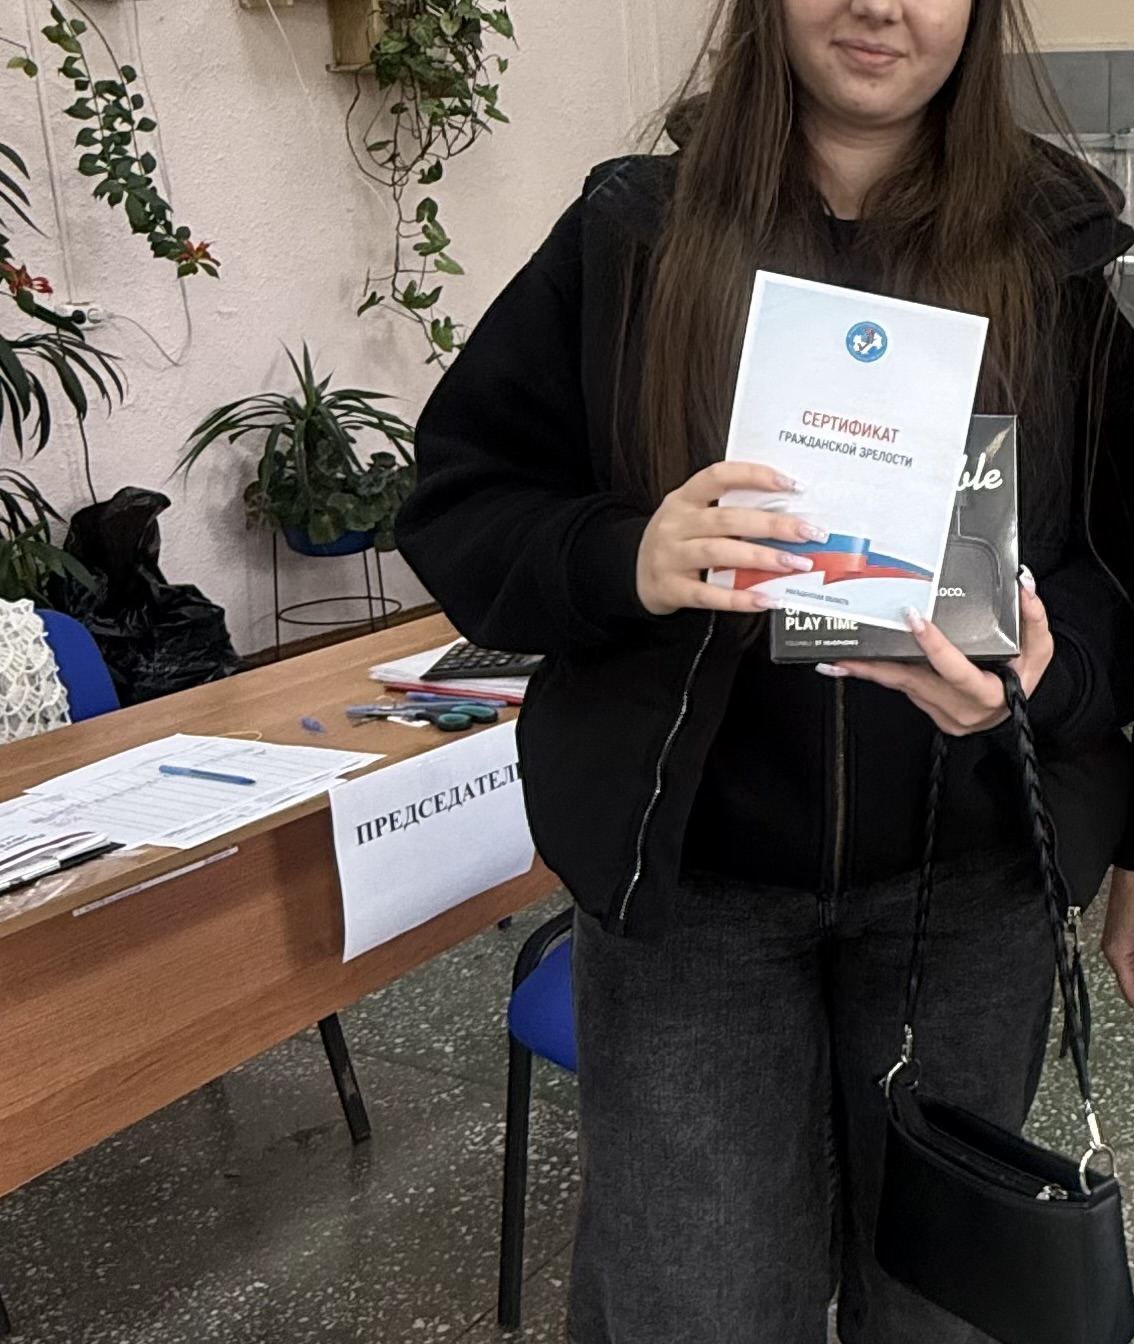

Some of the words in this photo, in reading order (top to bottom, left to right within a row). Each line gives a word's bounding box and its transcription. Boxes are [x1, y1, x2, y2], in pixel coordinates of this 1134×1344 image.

[802, 410, 899, 443] СЕРТИФИКАТ
[779, 430, 857, 456] ГРАЖДАНСКОЙ
[859, 446, 913, 468] ЗРЕЛОСТИ
[785, 616, 820, 631] PLAY
[826, 616, 859, 631] TIME
